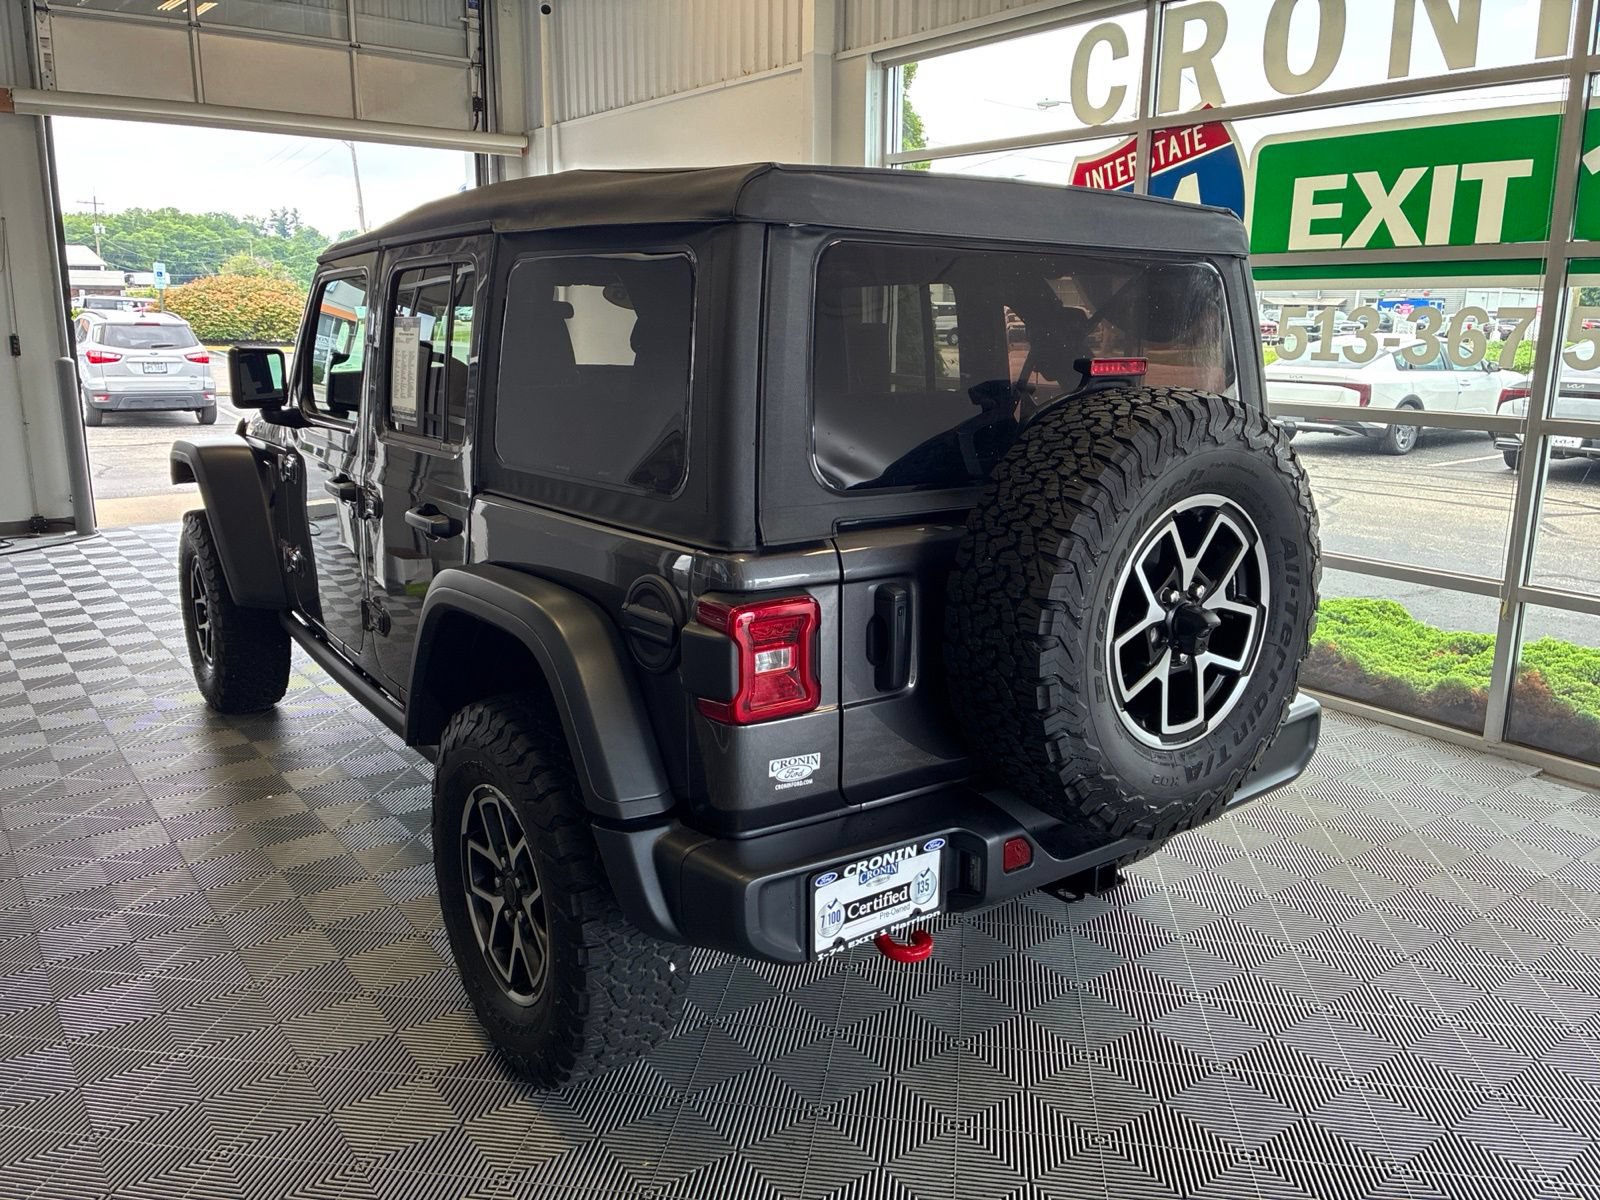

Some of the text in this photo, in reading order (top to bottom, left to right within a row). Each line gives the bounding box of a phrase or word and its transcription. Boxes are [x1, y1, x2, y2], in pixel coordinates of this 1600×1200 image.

[1085, 124, 1207, 189] INTERTATE
[1287, 158, 1534, 251] EXIT
[770, 754, 819, 773] CRONIN
[784, 767, 805, 779] Ford
[843, 844, 918, 878] CRONIN
[859, 862, 898, 884] CRONIN
[847, 885, 909, 919] Certified
[916, 881, 930, 895] 135
[879, 903, 911, 920] Pre-Owned
[816, 945, 845, 961] I-74
[847, 931, 877, 949] EXIT
[890, 910, 941, 932] Harrison
